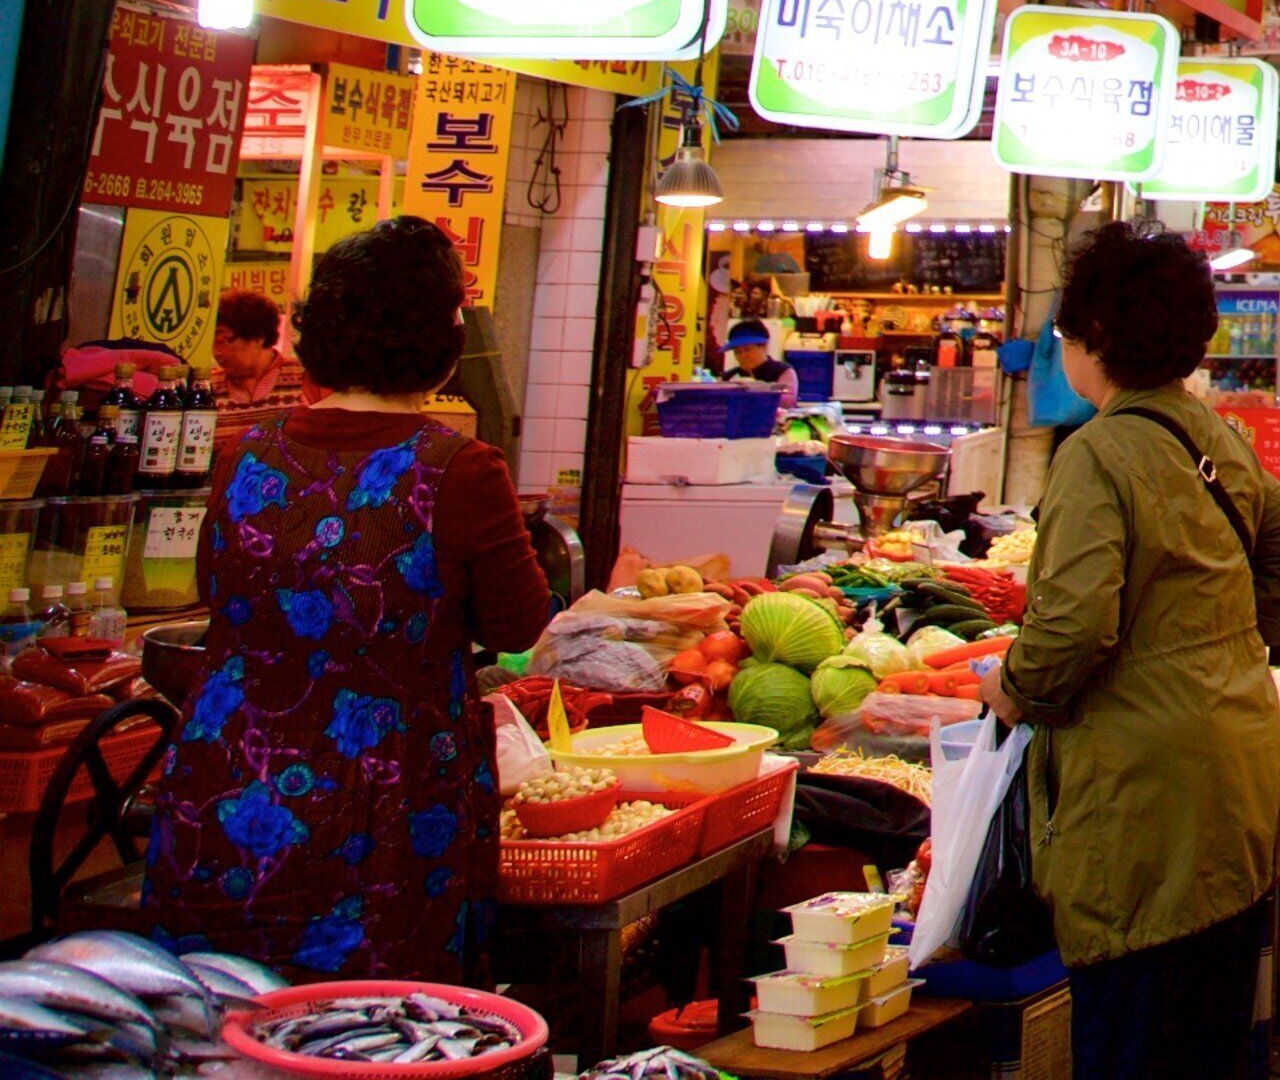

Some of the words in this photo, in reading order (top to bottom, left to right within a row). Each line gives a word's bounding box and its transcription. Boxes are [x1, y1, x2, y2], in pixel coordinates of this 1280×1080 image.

[173, 24, 218, 63] 전문점
[1060, 39, 1107, 60] 3A-10
[331, 76, 413, 130] 보수식육점
[1010, 72, 1153, 117] 보수식육점
[1235, 298, 1278, 313] ICEPIA
